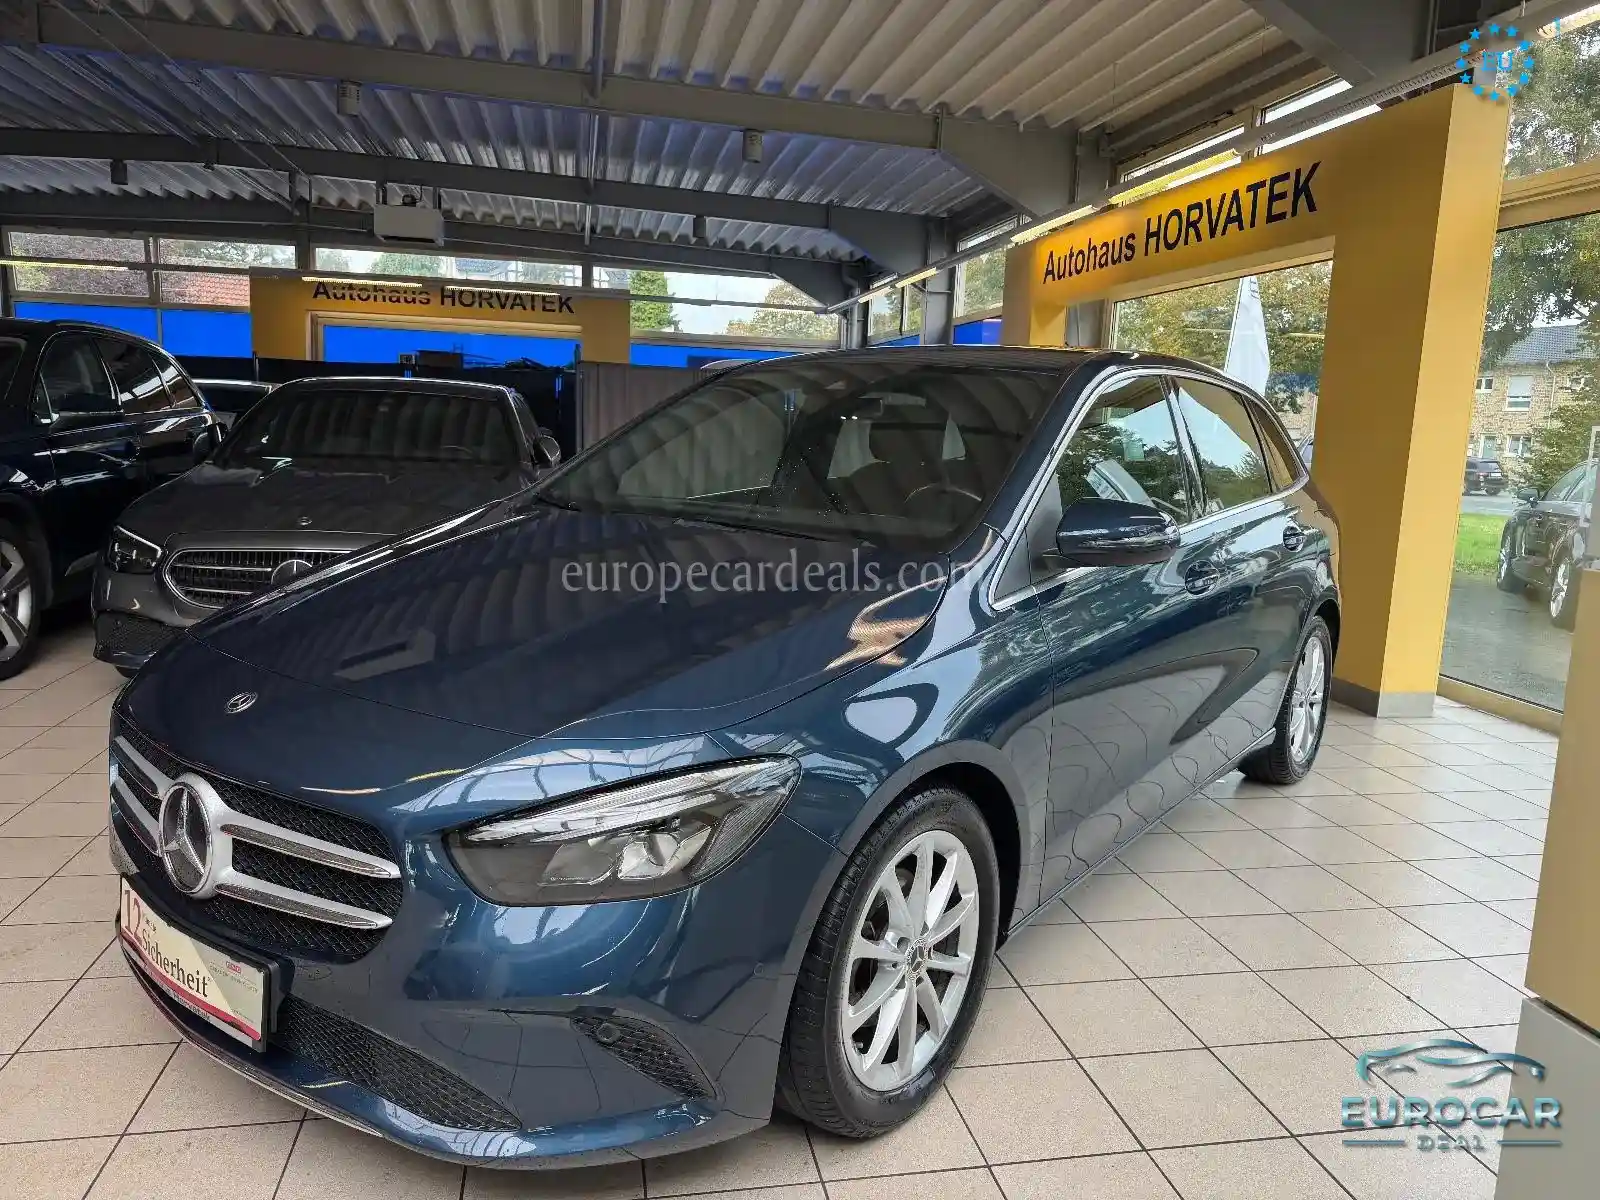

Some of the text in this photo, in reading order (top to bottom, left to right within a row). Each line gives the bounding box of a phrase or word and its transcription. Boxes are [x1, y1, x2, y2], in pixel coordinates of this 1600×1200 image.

[1042, 160, 1322, 284] Autohaus HORVATEK
[312, 281, 575, 314] Autohaus HORVATEK
[142, 928, 208, 998] Sicherheit
